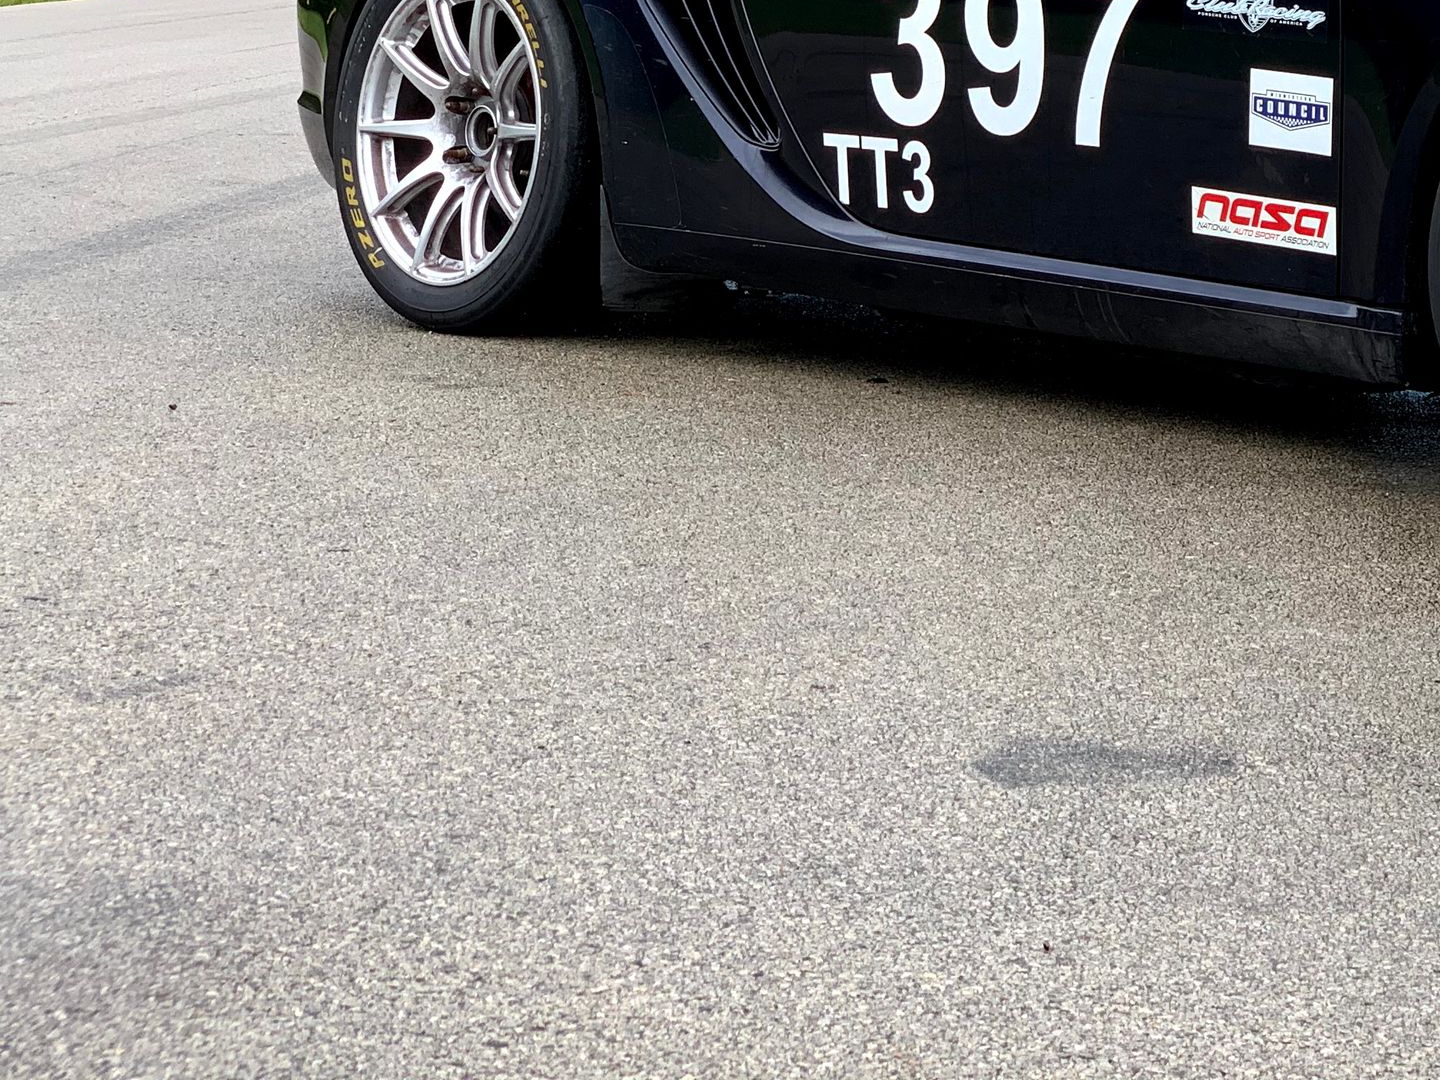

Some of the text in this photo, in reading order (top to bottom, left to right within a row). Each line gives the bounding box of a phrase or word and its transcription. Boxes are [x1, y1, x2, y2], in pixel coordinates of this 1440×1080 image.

[1256, 99, 1326, 121] COUNCIL
[823, 132, 934, 213] TT3
[1197, 192, 1329, 238] nasa
[1197, 221, 1330, 250] NATIONAL AUTO SPORT ASSOCIATION
